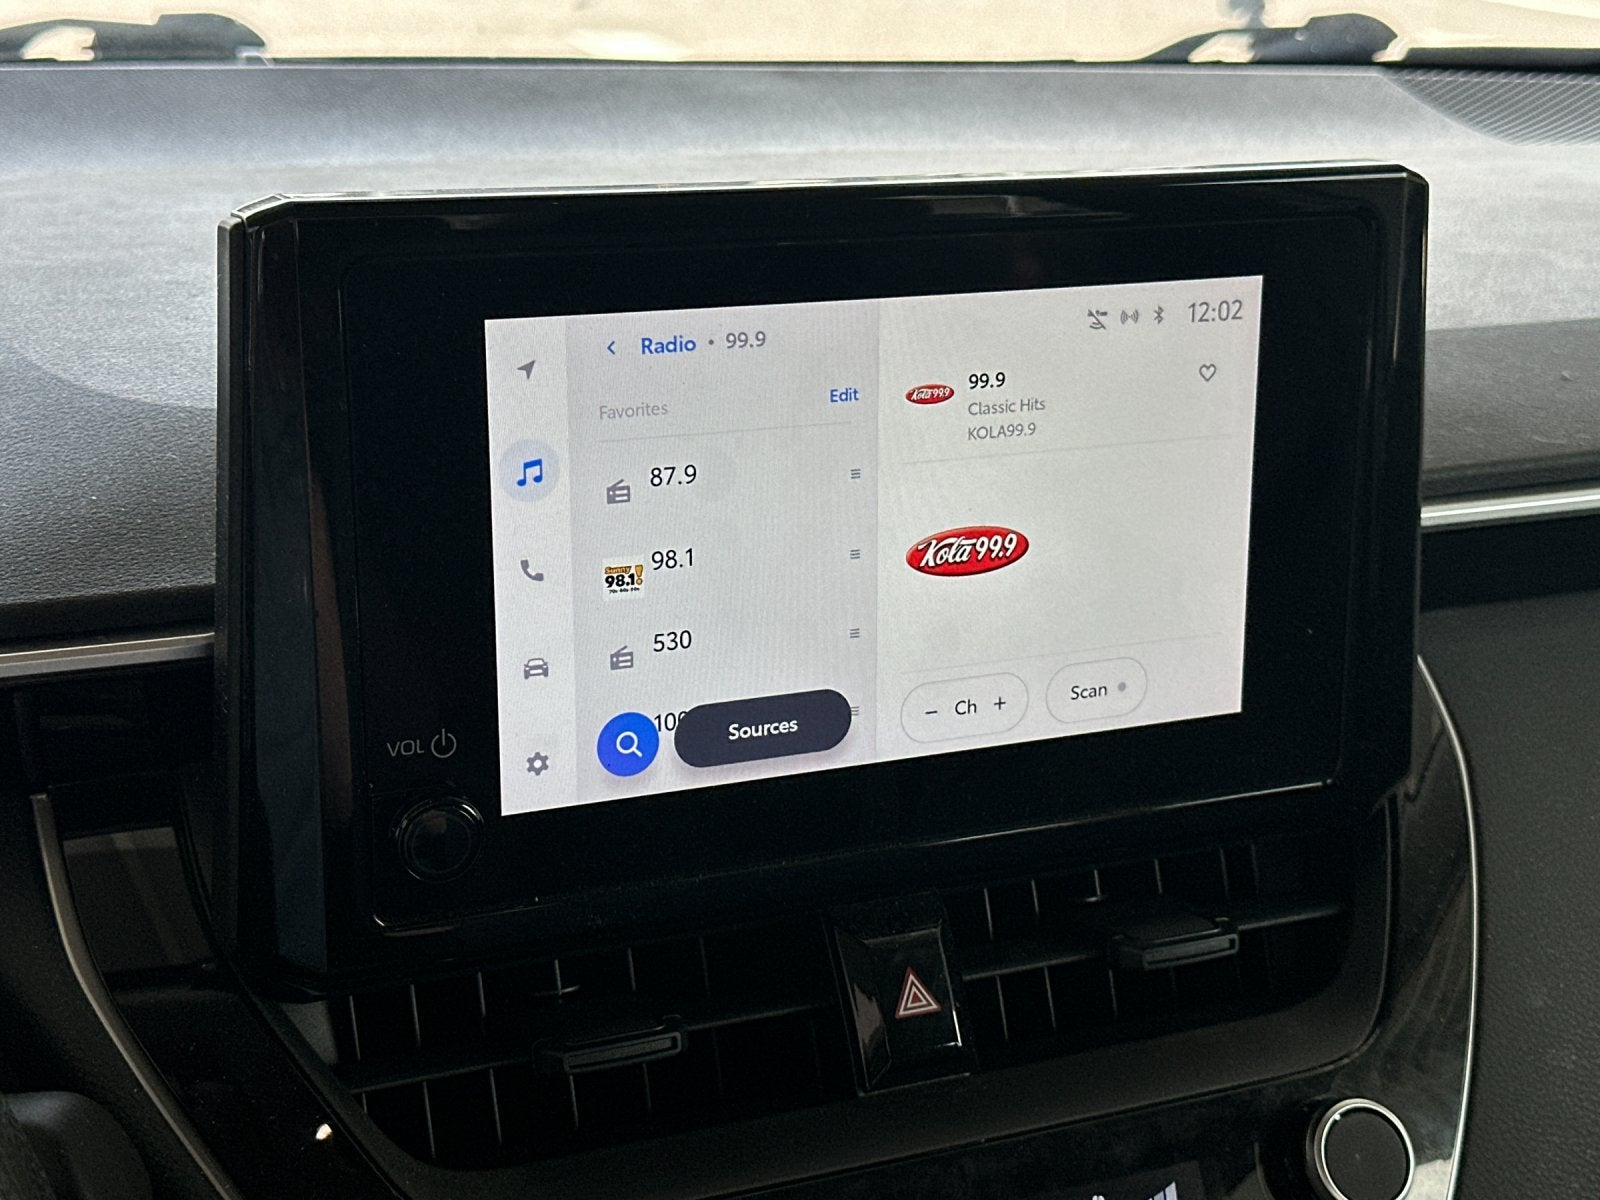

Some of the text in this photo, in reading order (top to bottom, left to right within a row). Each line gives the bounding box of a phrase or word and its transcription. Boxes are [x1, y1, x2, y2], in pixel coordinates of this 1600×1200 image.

[1188, 299, 1244, 323] 12:02
[640, 331, 767, 355] Radio 99.9
[968, 371, 1006, 390] 99.9
[829, 387, 860, 403] Edit
[598, 401, 668, 419] Favorites
[968, 397, 1046, 416] Classic Hits
[967, 422, 1036, 441] KOLA99.9
[650, 464, 697, 487] 87.9
[917, 532, 1018, 567] Kola 99.9
[651, 548, 694, 571] 98.1
[604, 565, 632, 574] Sunny
[652, 630, 692, 653] 530
[1070, 684, 1108, 700] Scan
[954, 699, 978, 716] Ch
[728, 718, 798, 741] Sources
[386, 739, 425, 757] VOL
